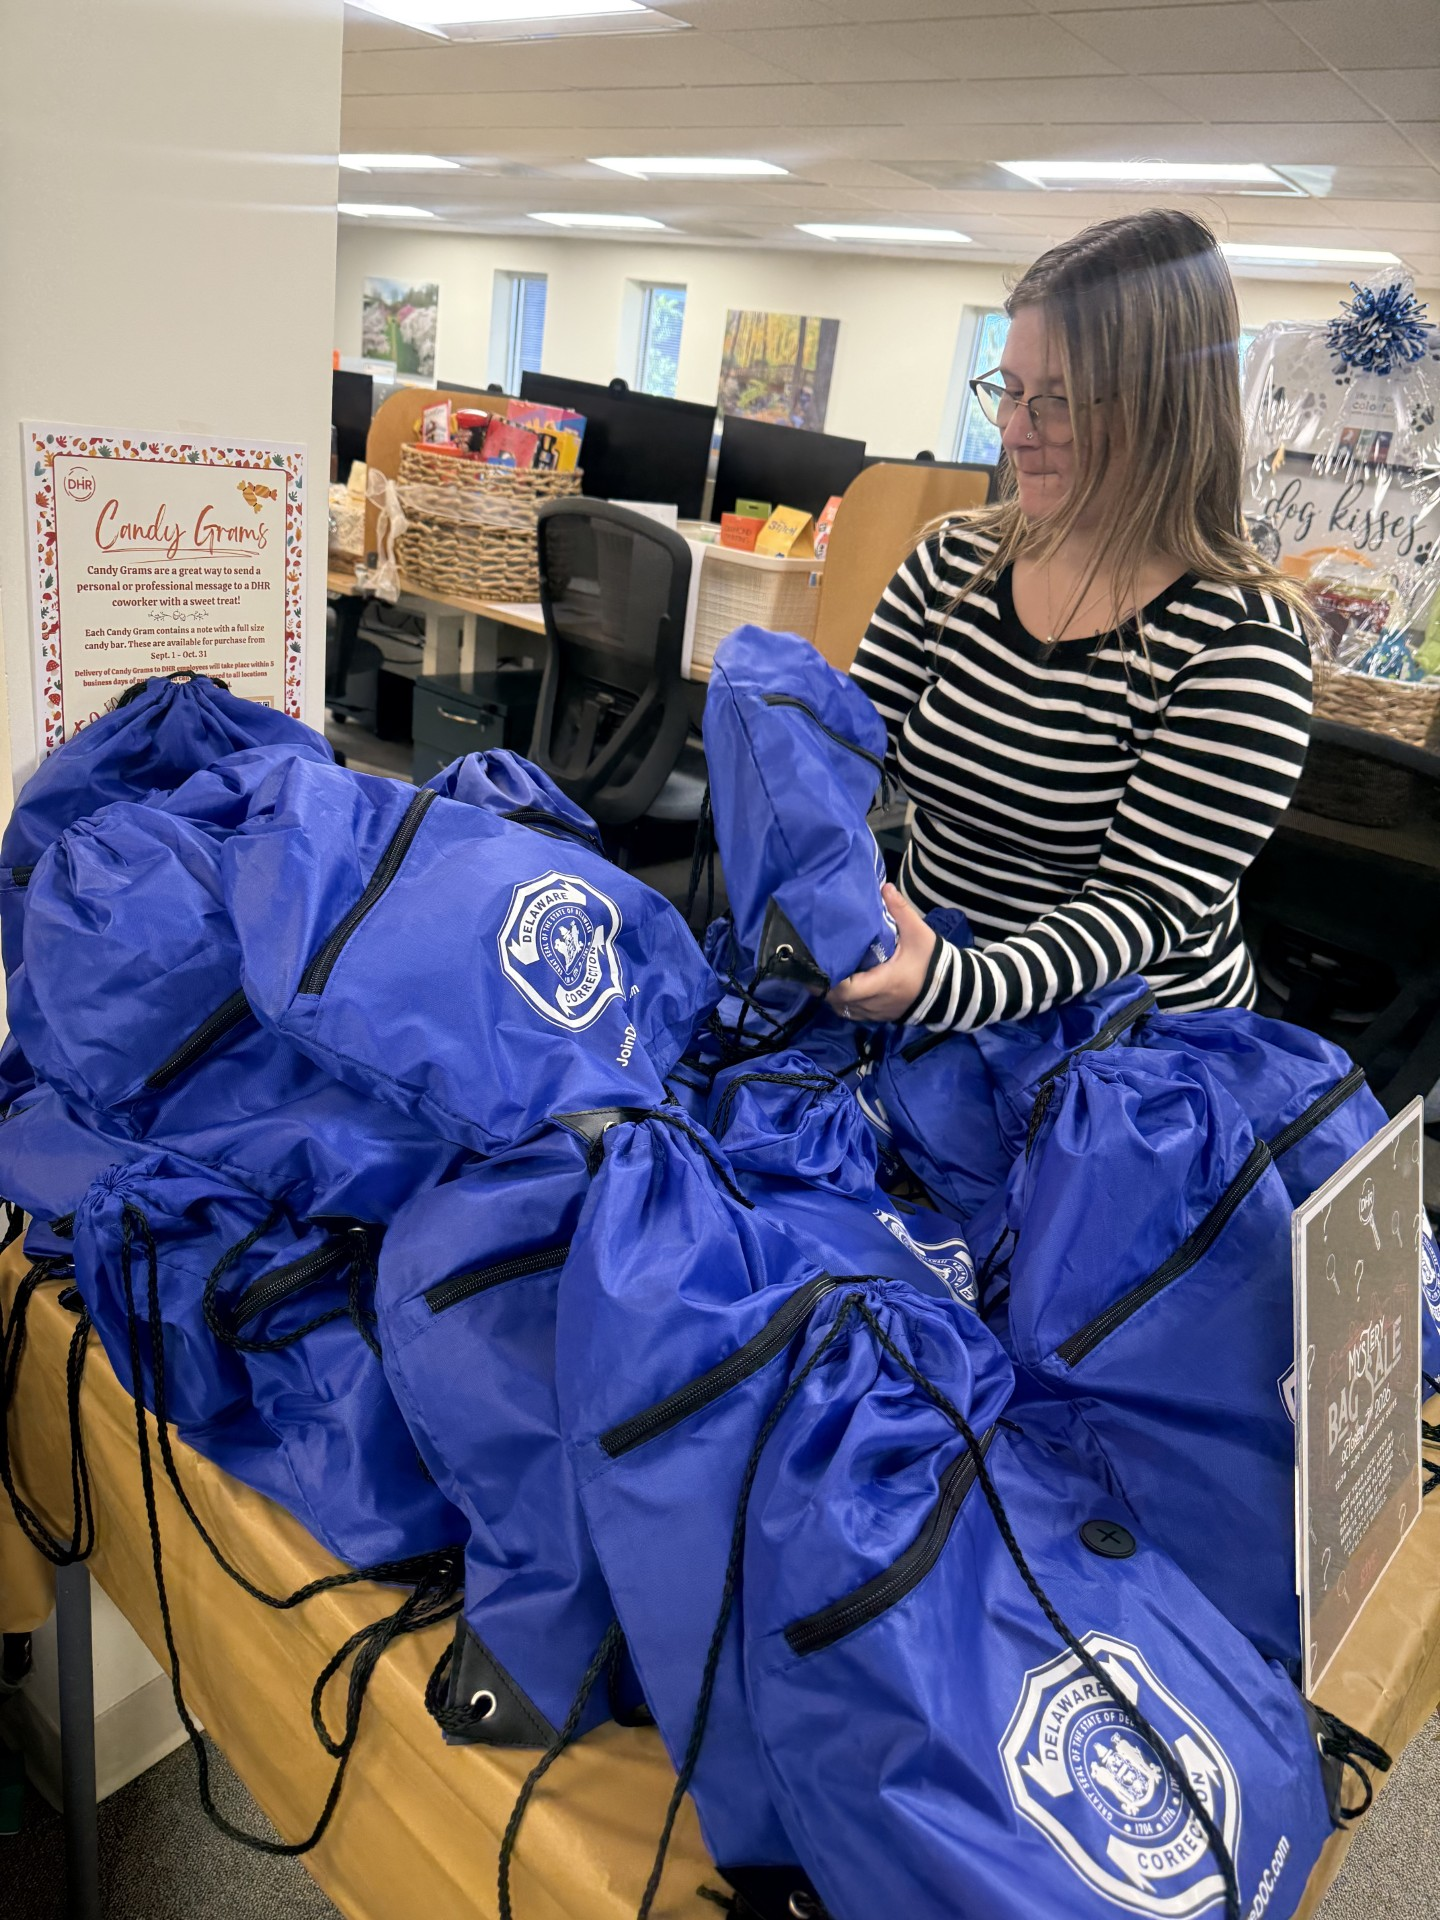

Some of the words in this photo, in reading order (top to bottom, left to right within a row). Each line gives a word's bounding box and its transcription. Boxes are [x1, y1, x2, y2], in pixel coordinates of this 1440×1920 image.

[68, 476, 92, 490] DHR
[1264, 478, 1319, 542] dog
[1328, 479, 1426, 556] kisses
[95, 499, 186, 559] Candy
[194, 505, 268, 555] Grams
[87, 565, 118, 576] Candy
[120, 565, 152, 575] Grams
[154, 567, 170, 575] are
[171, 567, 177, 575] a
[179, 567, 202, 577] great
[204, 568, 222, 577] way
[223, 567, 232, 575] to
[233, 566, 254, 575] send
[76, 581, 120, 593] personal
[122, 583, 134, 591] or
[135, 581, 193, 593] professional
[195, 583, 232, 593] message
[234, 582, 242, 590] to
[251, 581, 271, 590] DHR
[112, 597, 158, 607] coworker
[159, 597, 181, 606] with
[189, 597, 215, 606] sweet
[217, 596, 241, 605] treat!
[85, 628, 105, 637] Each
[106, 627, 132, 637] Candy
[132, 627, 155, 635] Gram
[156, 626, 189, 634] contains
[213, 624, 230, 633] with
[236, 624, 249, 632] full
[250, 624, 265, 632] size
[84, 641, 109, 651] candy
[110, 641, 127, 649] bar.
[127, 640, 152, 648] These
[166, 638, 201, 646] available
[202, 637, 214, 646] for
[214, 636, 247, 646] purchase
[247, 636, 266, 644] from
[150, 652, 170, 661] Sept.
[171, 651, 176, 659] 1
[198, 650, 208, 658] 31
[74, 669, 103, 677] Delivery
[104, 668, 111, 676] of
[111, 667, 132, 676] Candy
[132, 666, 153, 674] Grams
[176, 664, 208, 672] employees
[209, 662, 220, 670] will
[234, 662, 250, 670] place
[83, 679, 112, 687] business
[113, 678, 128, 686] days
[241, 670, 268, 678] locations
[522, 892, 568, 943] DELAWARE
[549, 908, 566, 921] STATE
[543, 920, 553, 932] THE
[543, 942, 553, 958] SEAL
[564, 946, 599, 1004] CORRECTION
[1348, 1314, 1385, 1381] MYSTERY
[1328, 1374, 1359, 1457] BAG
[1365, 1314, 1402, 1402] SALE
[1361, 1416, 1385, 1454] SECRETARY
[1386, 1397, 1397, 1419] SUITE
[1045, 1683, 1109, 1762] DELAWARE
[1081, 1712, 1103, 1733] STATE
[1103, 1711, 1116, 1722] OF
[1072, 1732, 1085, 1747] THE
[1072, 1749, 1081, 1761] OF
[1076, 1766, 1090, 1790] SEAL
[1088, 1793, 1113, 1821] GREAT
[1137, 1771, 1208, 1870] CORRECON
[1160, 1806, 1177, 1827] 1776
[1135, 1823, 1154, 1835] 1704
